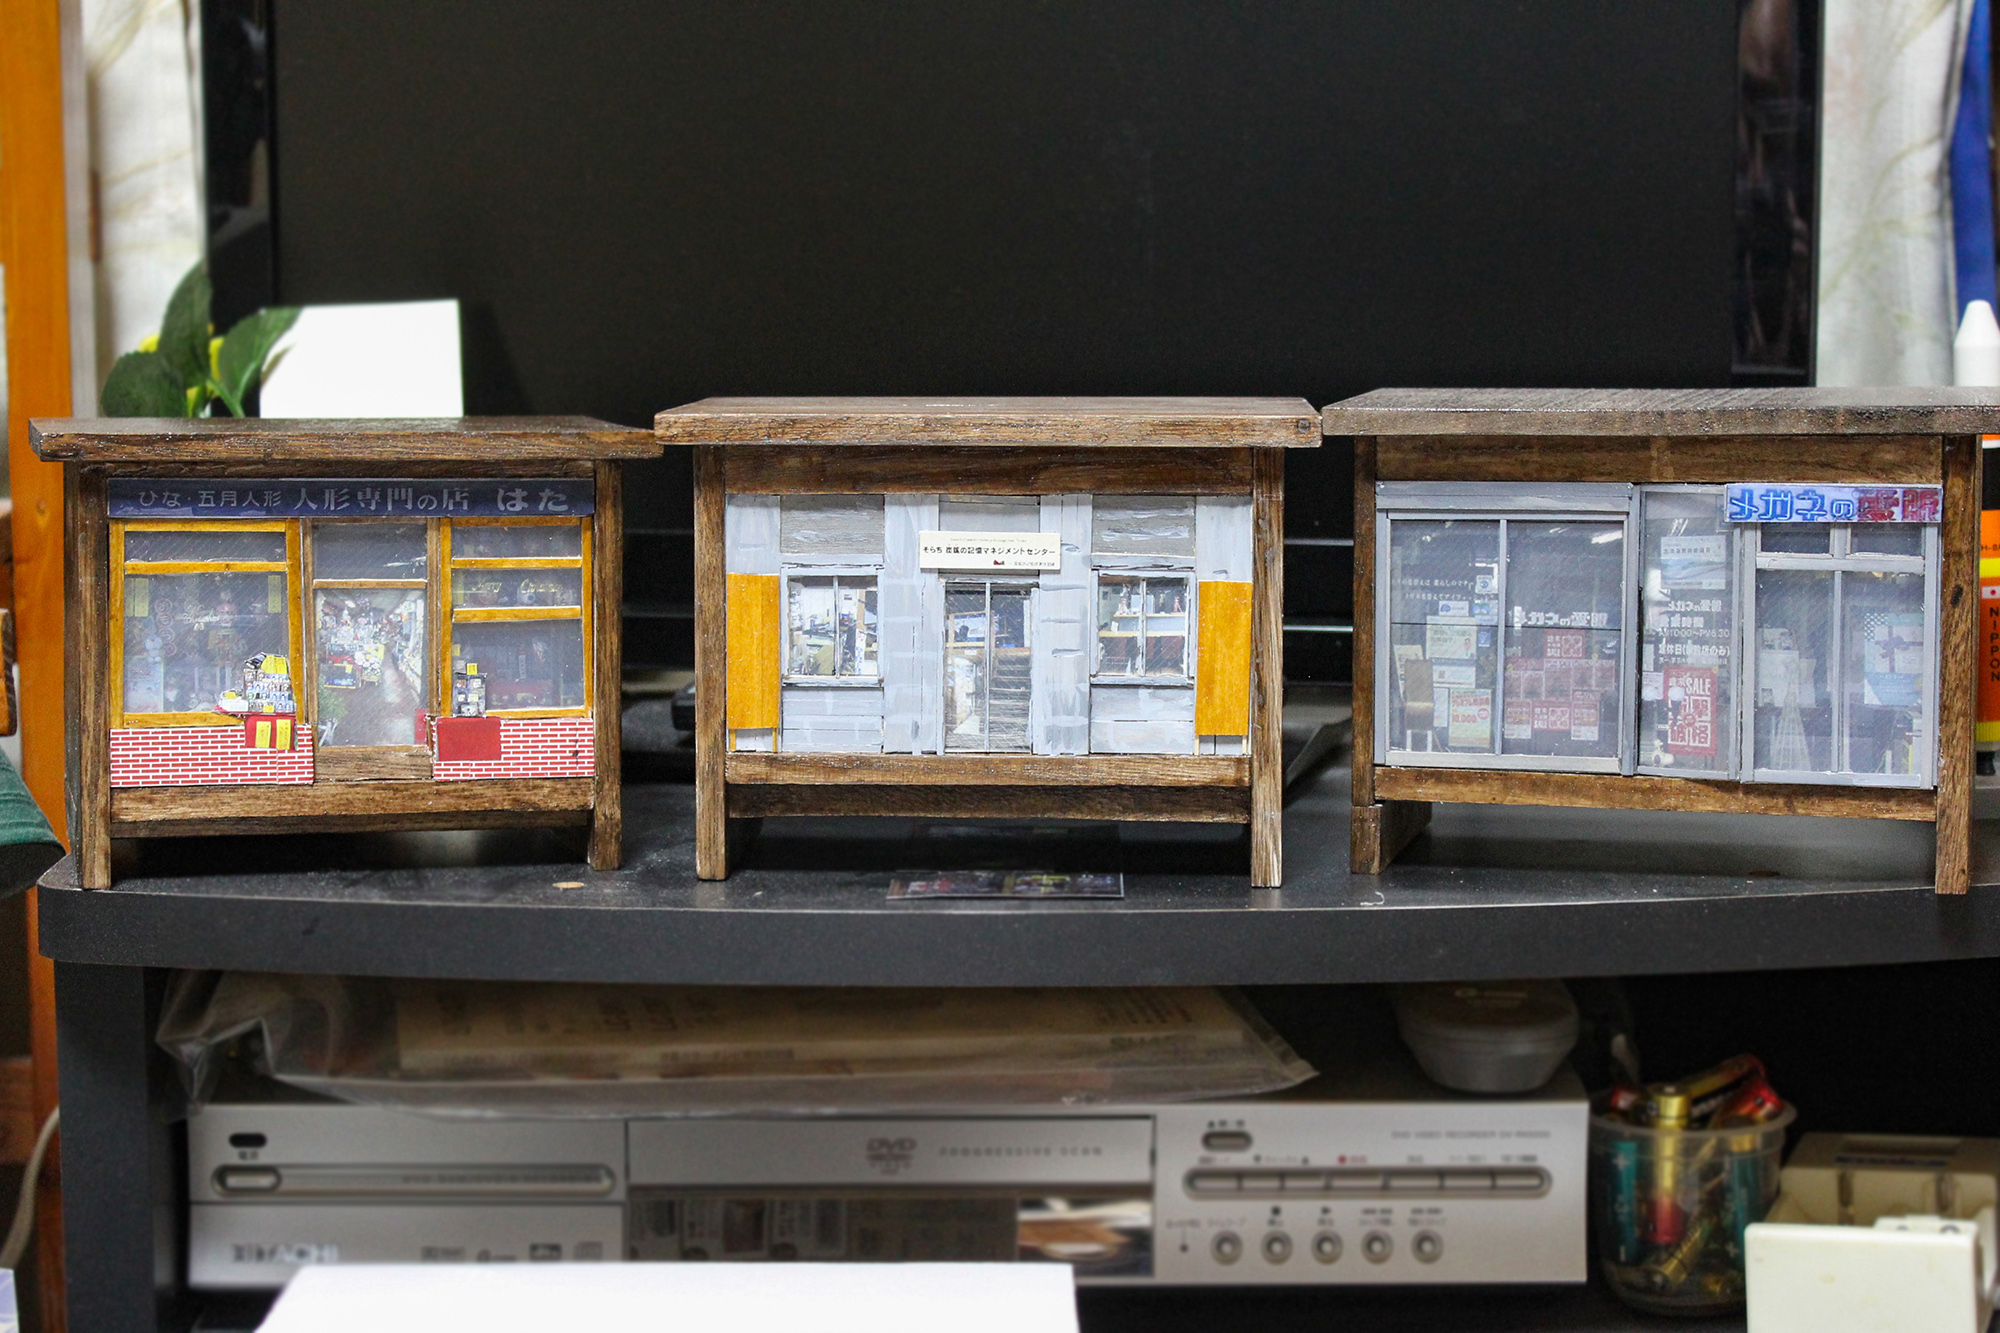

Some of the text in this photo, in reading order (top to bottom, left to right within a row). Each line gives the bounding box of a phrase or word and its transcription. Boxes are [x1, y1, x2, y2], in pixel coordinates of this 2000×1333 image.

[293, 488, 469, 511] 人形専門の店
[496, 488, 570, 512] はた
[923, 546, 943, 554] そらち
[1989, 607, 2000, 682] NIPPON
[1686, 678, 1711, 695] SALE
[866, 1137, 918, 1152] DVD
